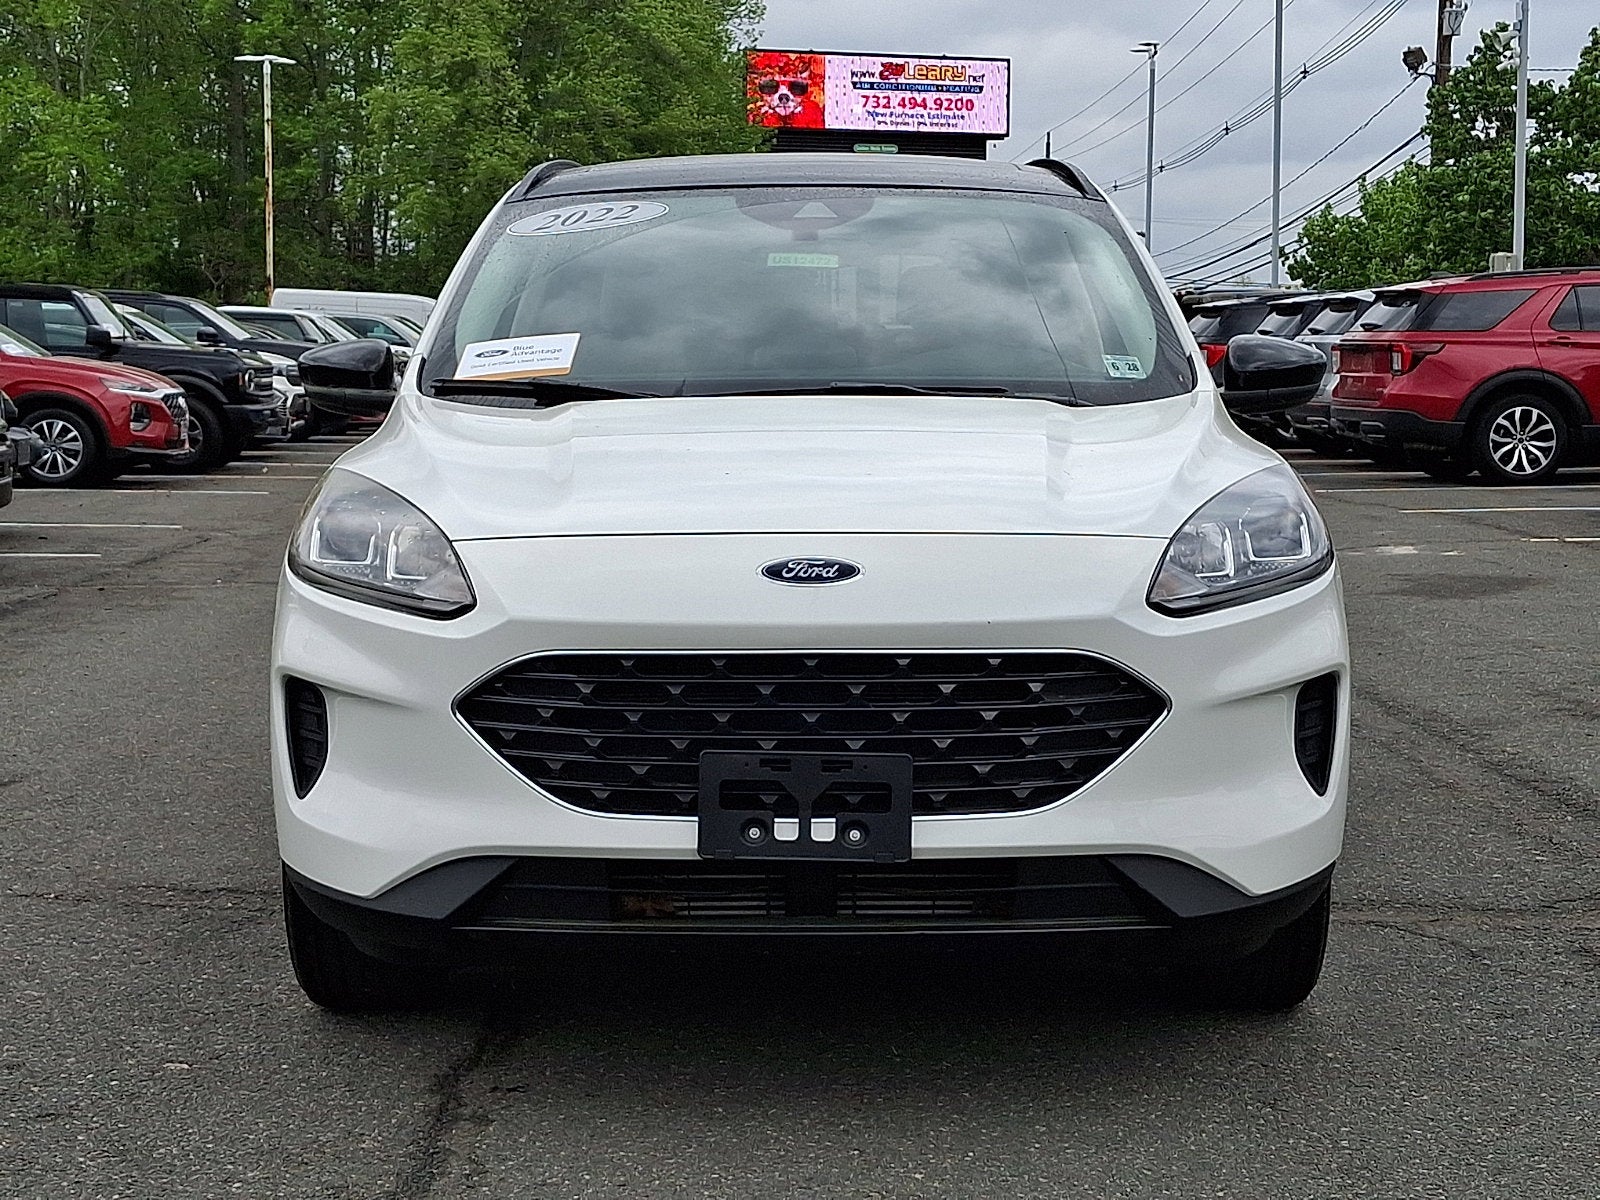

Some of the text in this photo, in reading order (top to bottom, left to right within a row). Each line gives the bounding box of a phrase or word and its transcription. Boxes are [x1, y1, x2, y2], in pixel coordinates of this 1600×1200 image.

[861, 95, 975, 111] 732.494.9200
[532, 204, 640, 232] 2022
[510, 348, 563, 358] Advantage
[1111, 362, 1140, 371] 6 28
[782, 560, 840, 578] Ford
